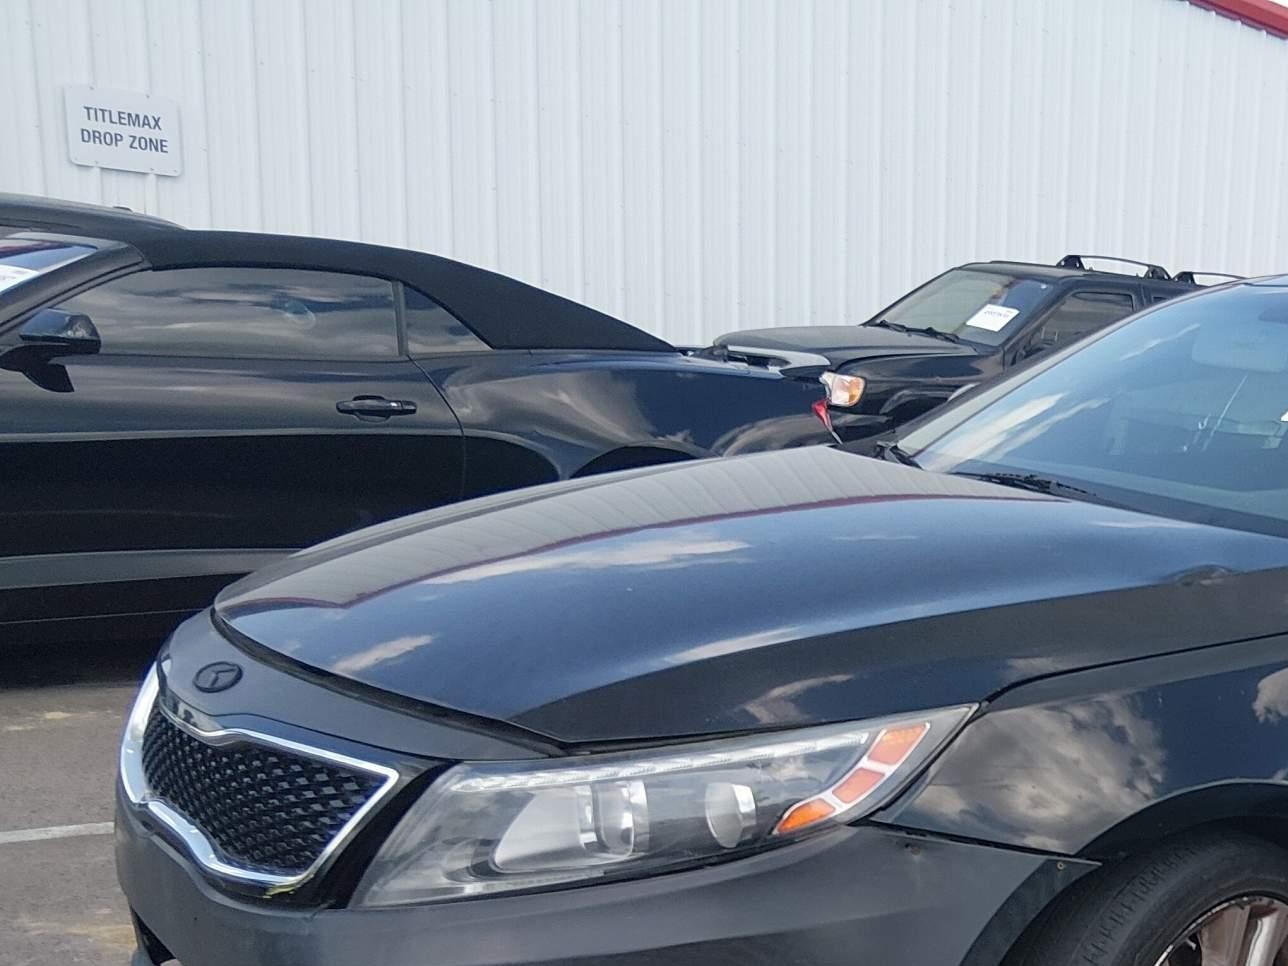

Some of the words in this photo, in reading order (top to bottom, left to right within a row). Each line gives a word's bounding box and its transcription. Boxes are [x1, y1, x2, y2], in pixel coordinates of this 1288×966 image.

[83, 105, 162, 131] TITLEMAX
[80, 127, 124, 148] DROP
[128, 134, 169, 154] ZONE
